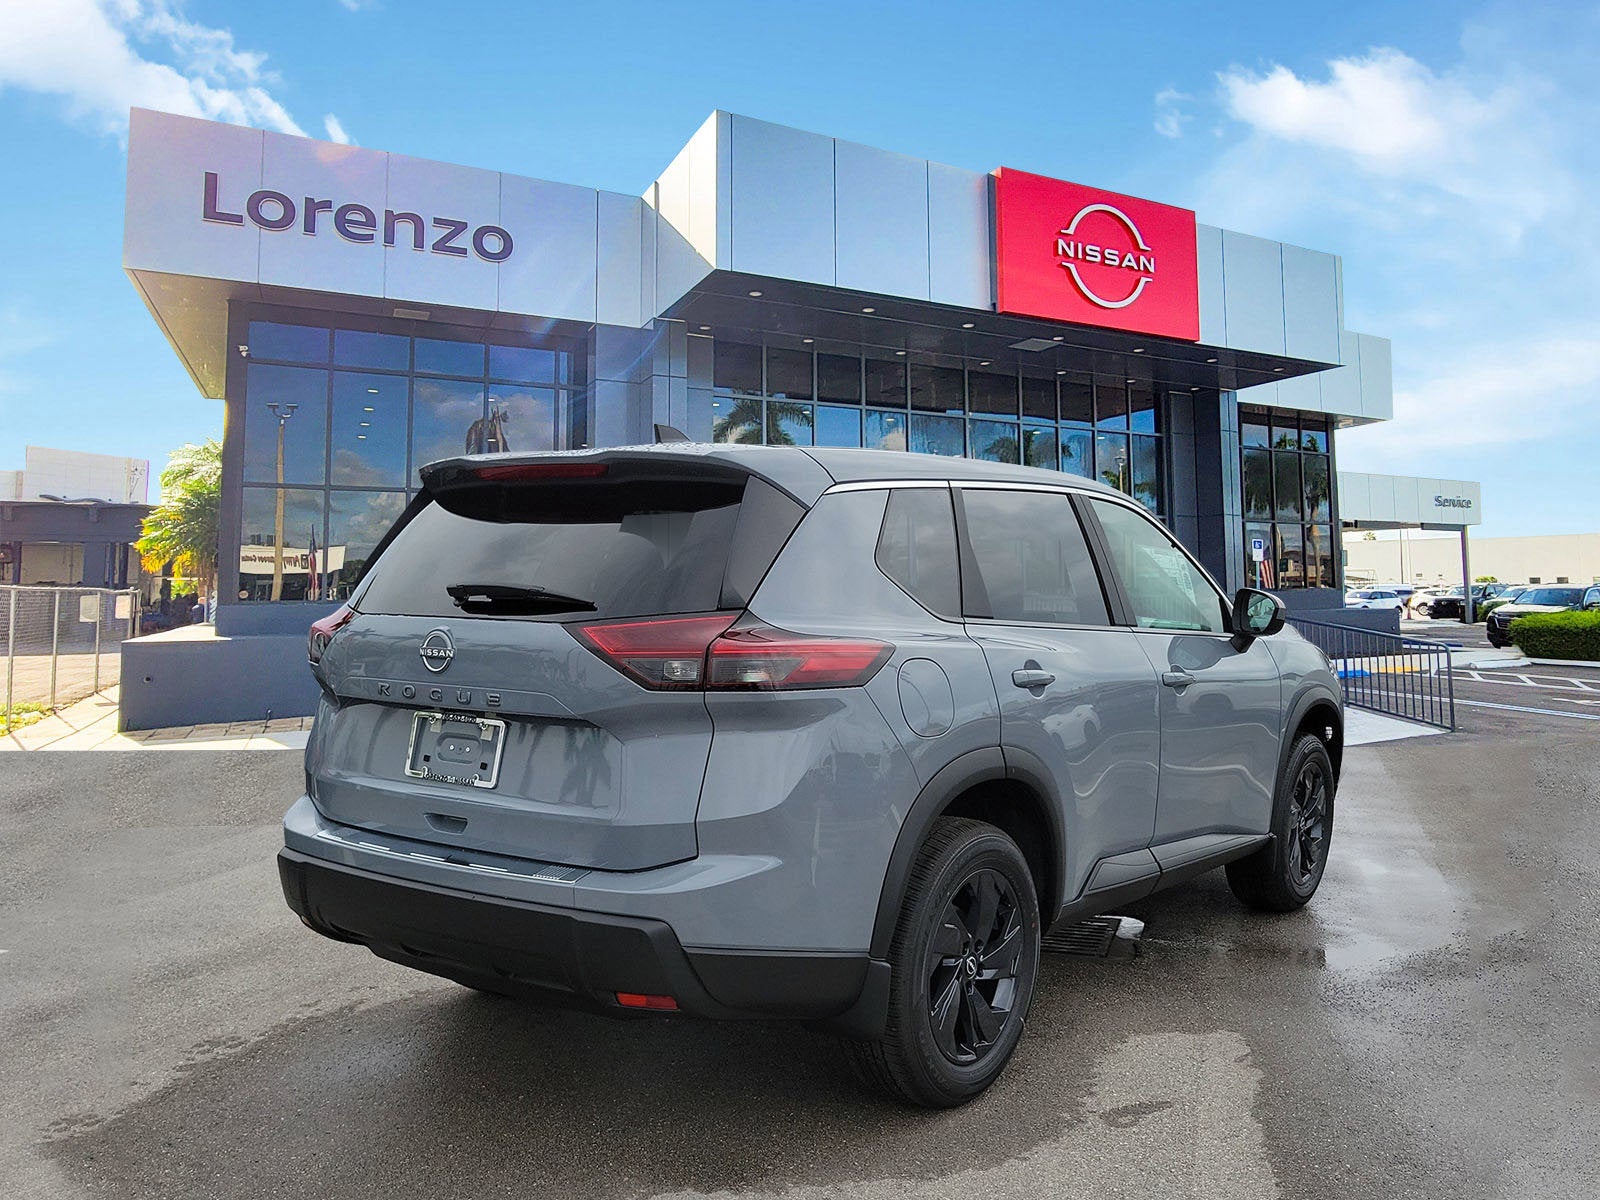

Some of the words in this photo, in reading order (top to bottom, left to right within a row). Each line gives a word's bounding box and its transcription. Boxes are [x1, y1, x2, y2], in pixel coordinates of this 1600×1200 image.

[202, 171, 514, 262] Lorenzo
[1057, 238, 1155, 273] NISSAN
[1434, 495, 1472, 508] Service
[419, 647, 454, 658] NISSAN
[377, 682, 501, 706] ROGUE
